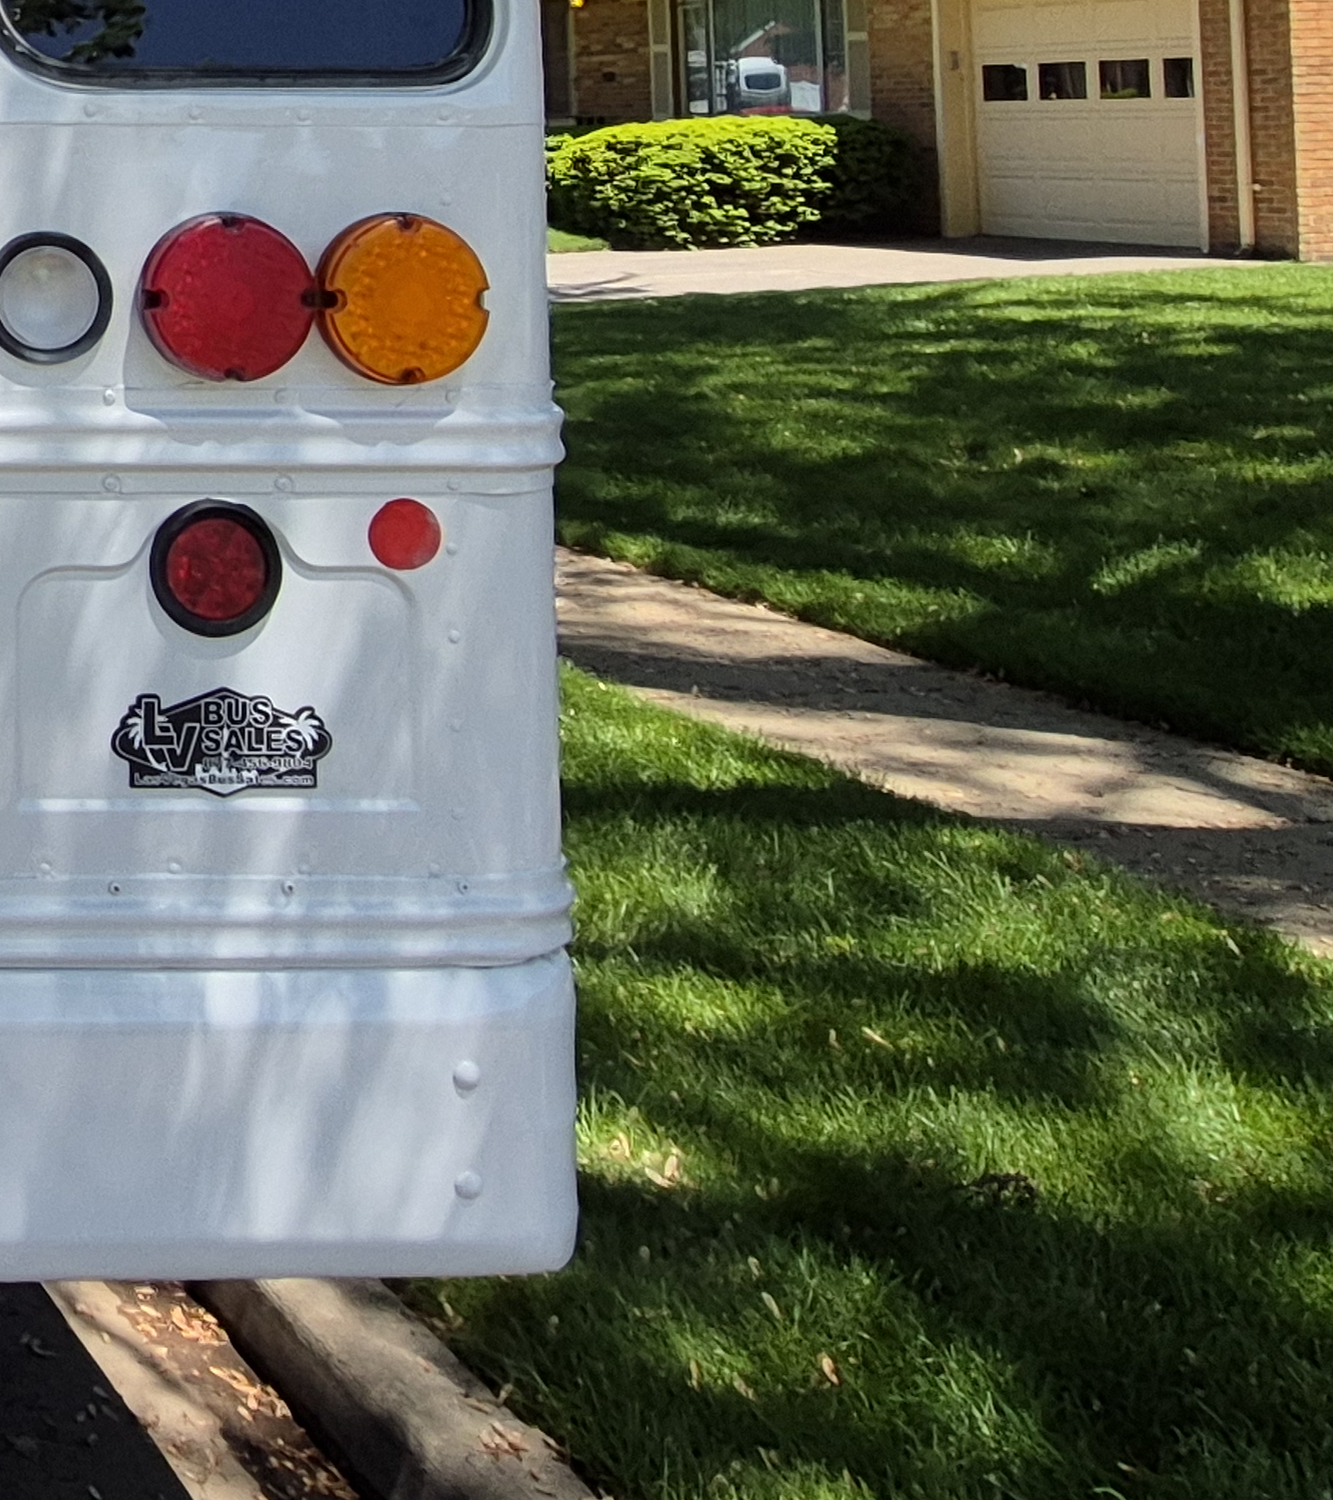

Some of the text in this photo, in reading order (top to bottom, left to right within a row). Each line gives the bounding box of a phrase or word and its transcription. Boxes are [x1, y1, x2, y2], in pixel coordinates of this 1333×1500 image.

[201, 697, 272, 727] BUS
[142, 698, 200, 771] LV
[200, 727, 308, 753] SALES
